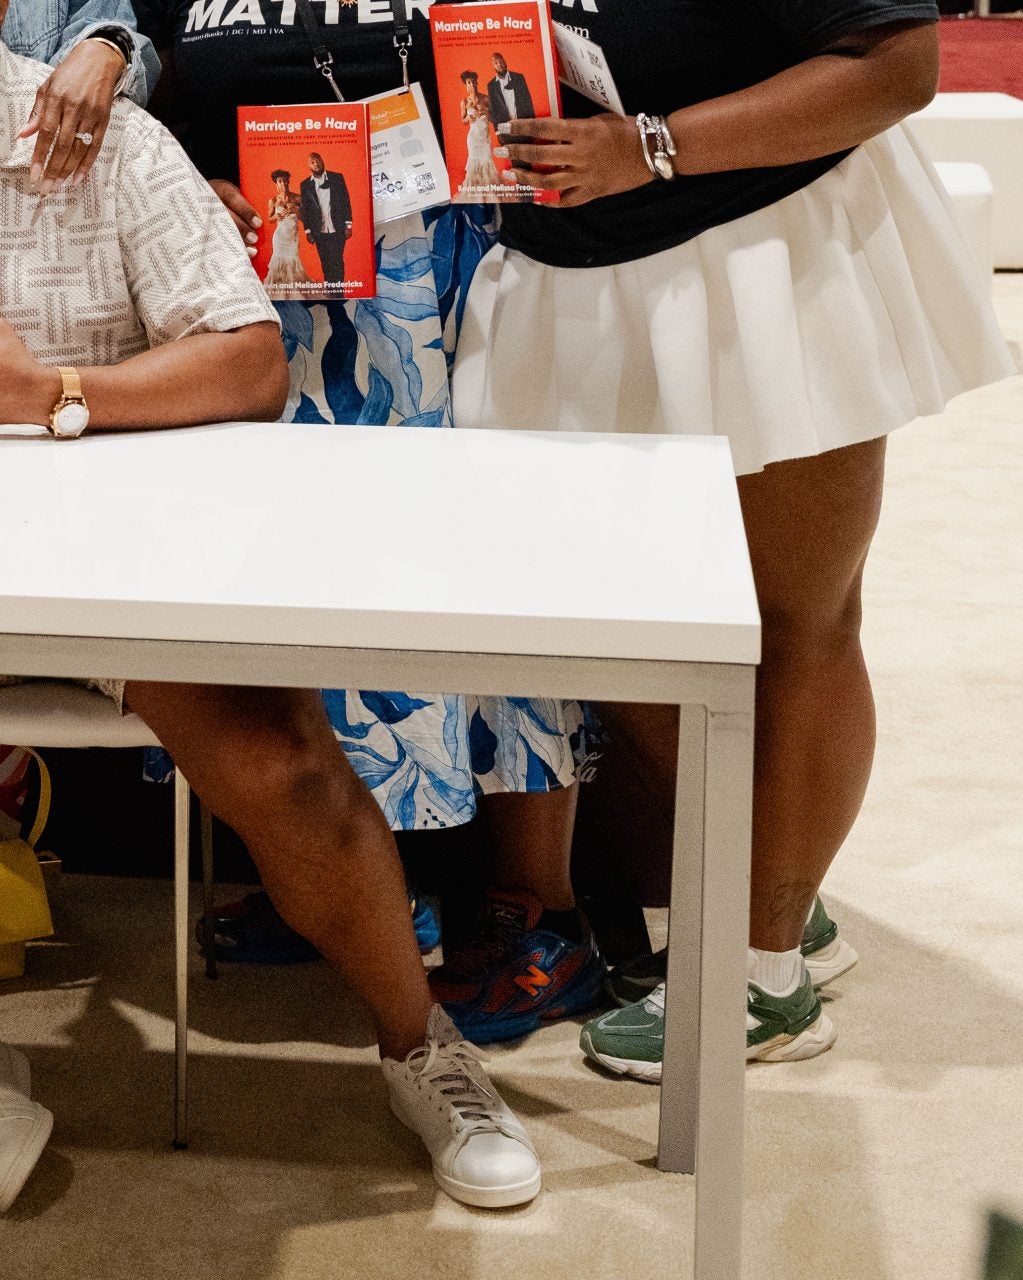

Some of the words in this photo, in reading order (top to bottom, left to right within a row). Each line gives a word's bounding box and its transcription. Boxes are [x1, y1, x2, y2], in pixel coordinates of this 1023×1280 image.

[434, 20, 484, 34] Marriage
[485, 18, 501, 30] Be
[503, 16, 533, 30] Hard
[244, 120, 303, 134] Marriage
[304, 118, 322, 130] Be
[324, 117, 357, 131] Hard
[279, 281, 294, 289] and
[295, 281, 323, 289] Melissa
[324, 280, 364, 288] Fredericks
